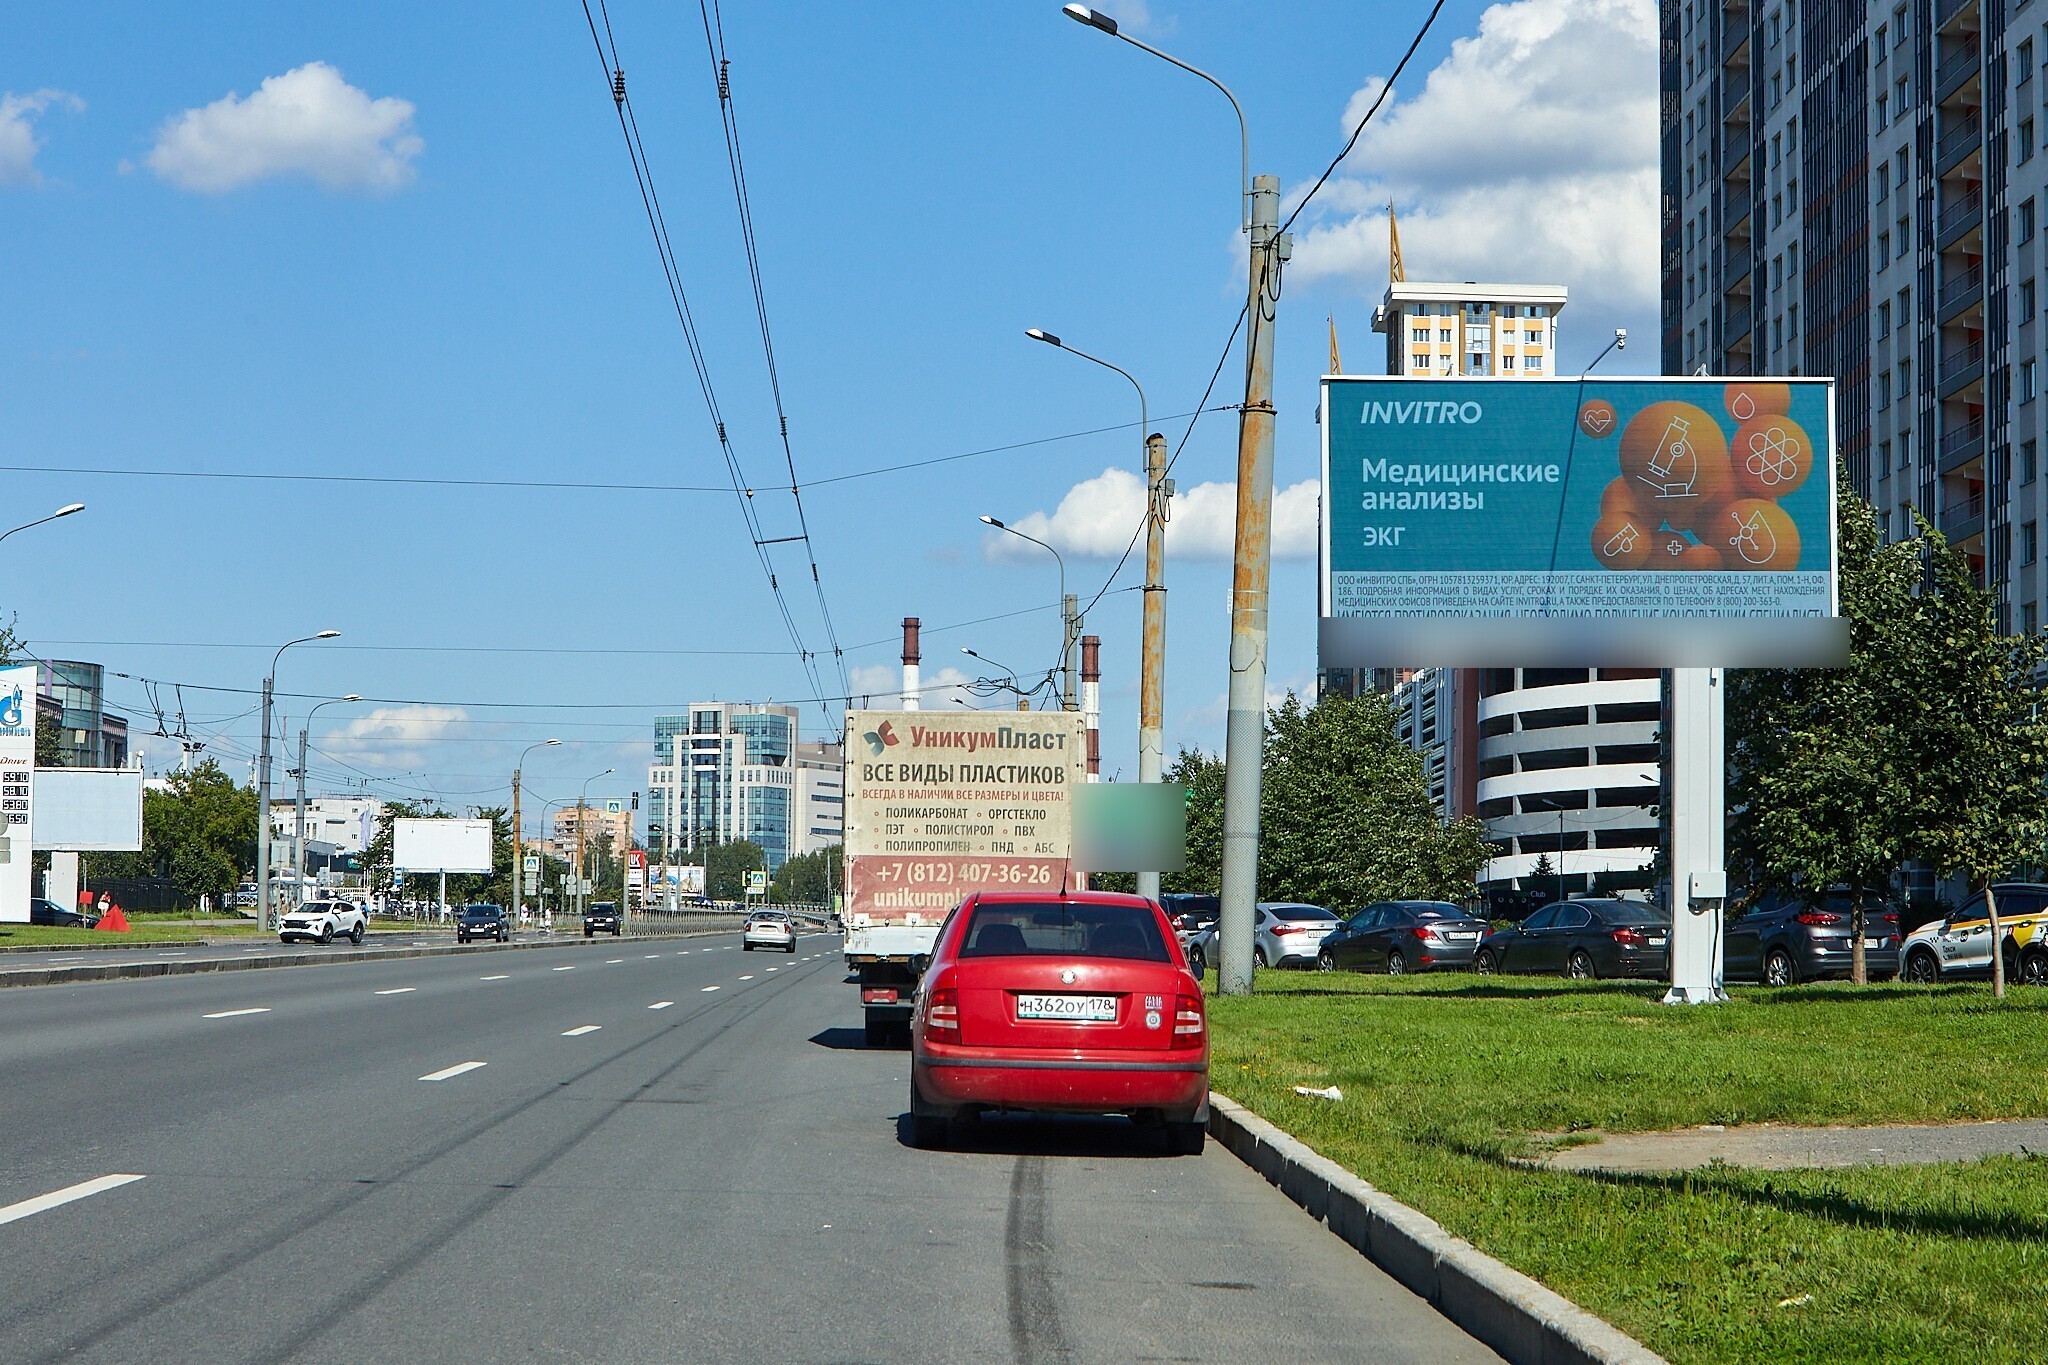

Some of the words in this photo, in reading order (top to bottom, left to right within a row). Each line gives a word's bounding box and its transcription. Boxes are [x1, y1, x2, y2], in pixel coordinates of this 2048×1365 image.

[1360, 401, 1483, 424] INVITRO
[1362, 458, 1560, 487] Медицинские
[1361, 491, 1484, 510] анализы
[1363, 526, 1406, 547] ЭКГ
[1337, 575, 1355, 585] ООО
[1356, 575, 1396, 585] «ИНВИТРО
[1419, 575, 1438, 585] ОГРН
[1338, 586, 1353, 596] 186.
[1356, 586, 1402, 596] ПОДРОБНАЯ
[1406, 586, 1460, 596] ИНФОРМАЦИЯ
[1463, 586, 1469, 596] О
[1473, 586, 1498, 596] ВИДАХ
[1501, 586, 1524, 596] УСЛУГ,
[1527, 586, 1556, 596] СРОКАХ
[1559, 586, 1565, 596] И
[1568, 586, 1603, 596] ПОРЯДКЕ
[1606, 586, 1617, 596] ИХ
[1620, 586, 1661, 596] ОКАЗАНИЯ,
[1664, 586, 1670, 596] О
[1673, 586, 1699, 596] ЦЕНАХ,
[1702, 586, 1713, 596] ОБ
[1715, 586, 1748, 596] АДРЕСАХ
[1751, 586, 1770, 596] МЕСТ
[1774, 586, 1825, 596] НАХОЖДЕНИЯ
[1338, 597, 1397, 607] МЕДИЦИНСКИХ
[1398, 597, 1431, 607] ОФИСОВ
[1432, 597, 1477, 607] ПРИВЕДЕНА
[1478, 597, 1489, 607] НА
[1490, 597, 1514, 607] САЙТЕ
[1559, 597, 1565, 607] А
[1565, 597, 1590, 607] ТАКЖЕ
[1591, 597, 1661, 607] ПРЕДОСТАВЛЯЕТСЯ
[1663, 597, 1674, 607] ПО
[1675, 597, 1715, 607] ТЕЛЕФОНУ
[1716, 597, 1722, 607] 8
[1723, 597, 1742, 607] (800)
[910, 725, 1067, 753] УникумПласт
[863, 764, 894, 782] ВСЕ
[899, 764, 954, 786] ВИДЫ
[959, 765, 1065, 784] ПЛАСТИКОВ
[862, 788, 897, 800] ВСЕГДА
[899, 789, 905, 799] В
[907, 789, 954, 800] НАЛИЧИИ
[956, 789, 972, 800] ВСЕ
[975, 790, 1020, 801] РАЗМЕРЫ
[1022, 791, 1029, 801] И
[1031, 791, 1064, 803] ЦВЕТА!
[885, 807, 968, 820] ПОЛИКАРБОНАТ
[988, 808, 1046, 820] ОРГСТЕКЛО
[885, 824, 905, 835] ПЭТ
[925, 824, 994, 836] ПОЛИСТИРОЛ
[1014, 825, 1035, 837] ПВХ
[885, 840, 971, 852] ПОЛИПРОПИЛЕН
[991, 842, 1014, 855] ПНД
[1034, 842, 1055, 853] АБС
[876, 863, 903, 882] +7
[907, 861, 954, 885] (812)
[957, 863, 1051, 884] 407-36-26
[874, 887, 968, 910] unikumpl
[1023, 997, 1085, 1013] Н362ОУ
[1088, 998, 1111, 1011] 178
